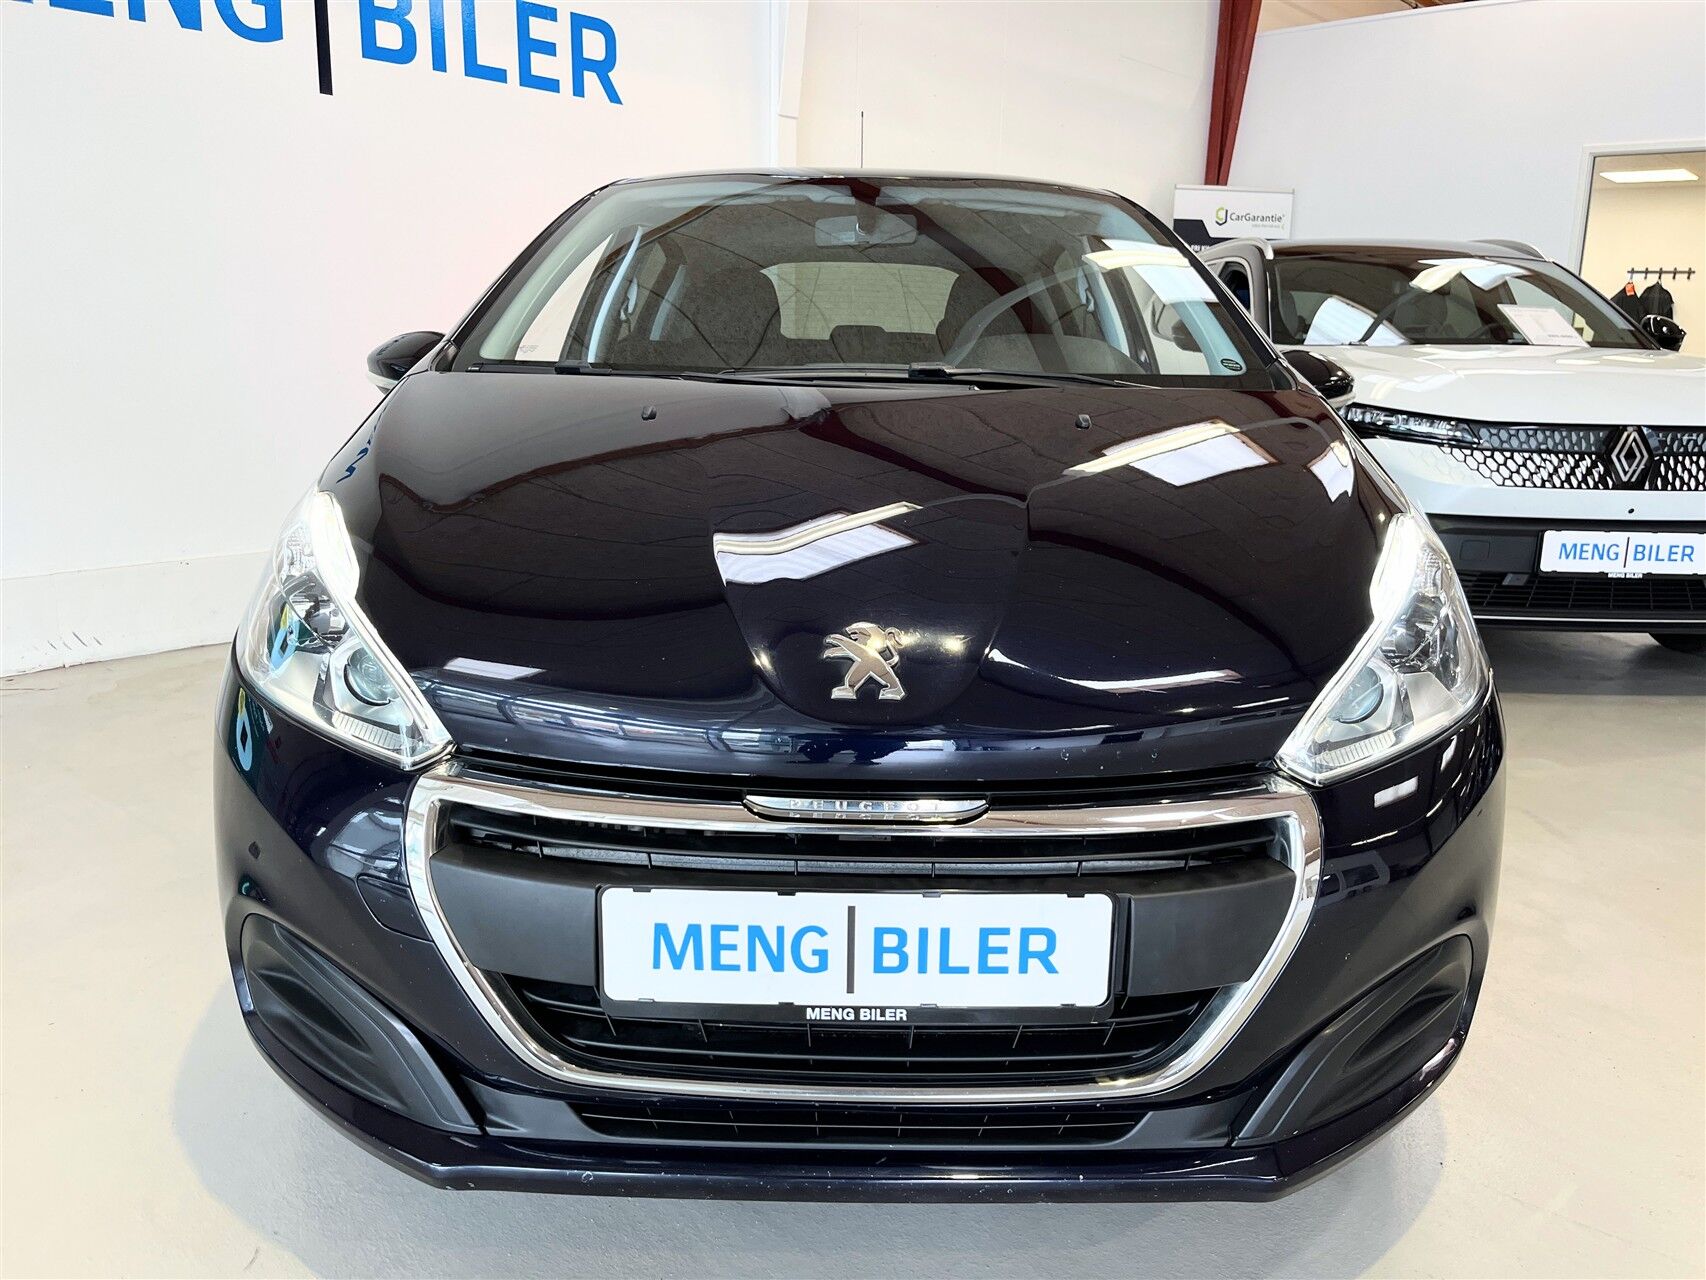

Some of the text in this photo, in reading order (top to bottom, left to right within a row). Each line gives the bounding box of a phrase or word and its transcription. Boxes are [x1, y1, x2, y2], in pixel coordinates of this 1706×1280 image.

[359, 0, 622, 105] BILER
[1229, 212, 1283, 222] CarGarantie
[1558, 543, 1695, 562] MENG BILER
[652, 922, 1059, 975] MENG BILER
[806, 1007, 908, 1022] MENG BILER
